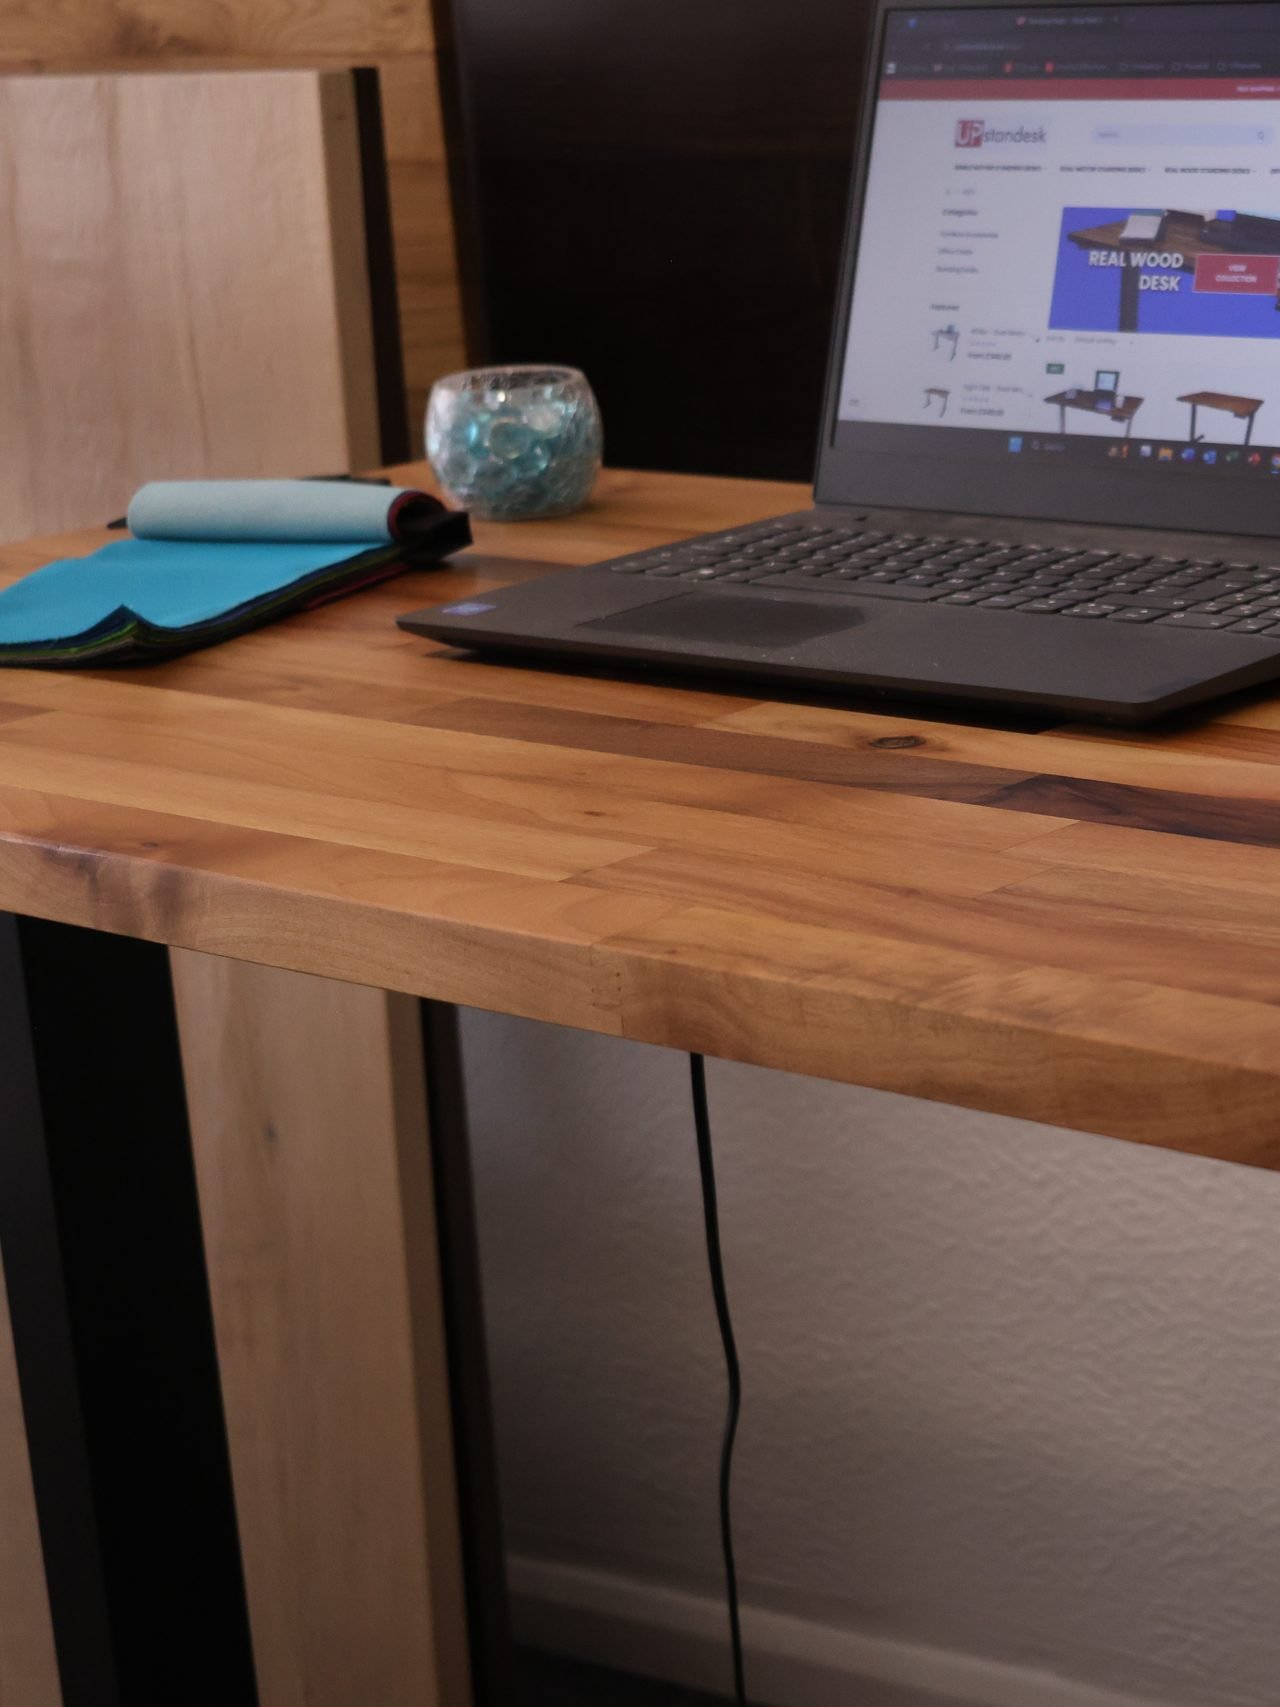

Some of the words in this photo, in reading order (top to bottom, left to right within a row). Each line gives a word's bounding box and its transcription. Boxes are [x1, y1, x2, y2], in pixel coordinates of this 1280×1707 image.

[1088, 251, 1127, 268] REAL
[1130, 252, 1184, 269] WOOD
[1138, 275, 1181, 291] DESK
